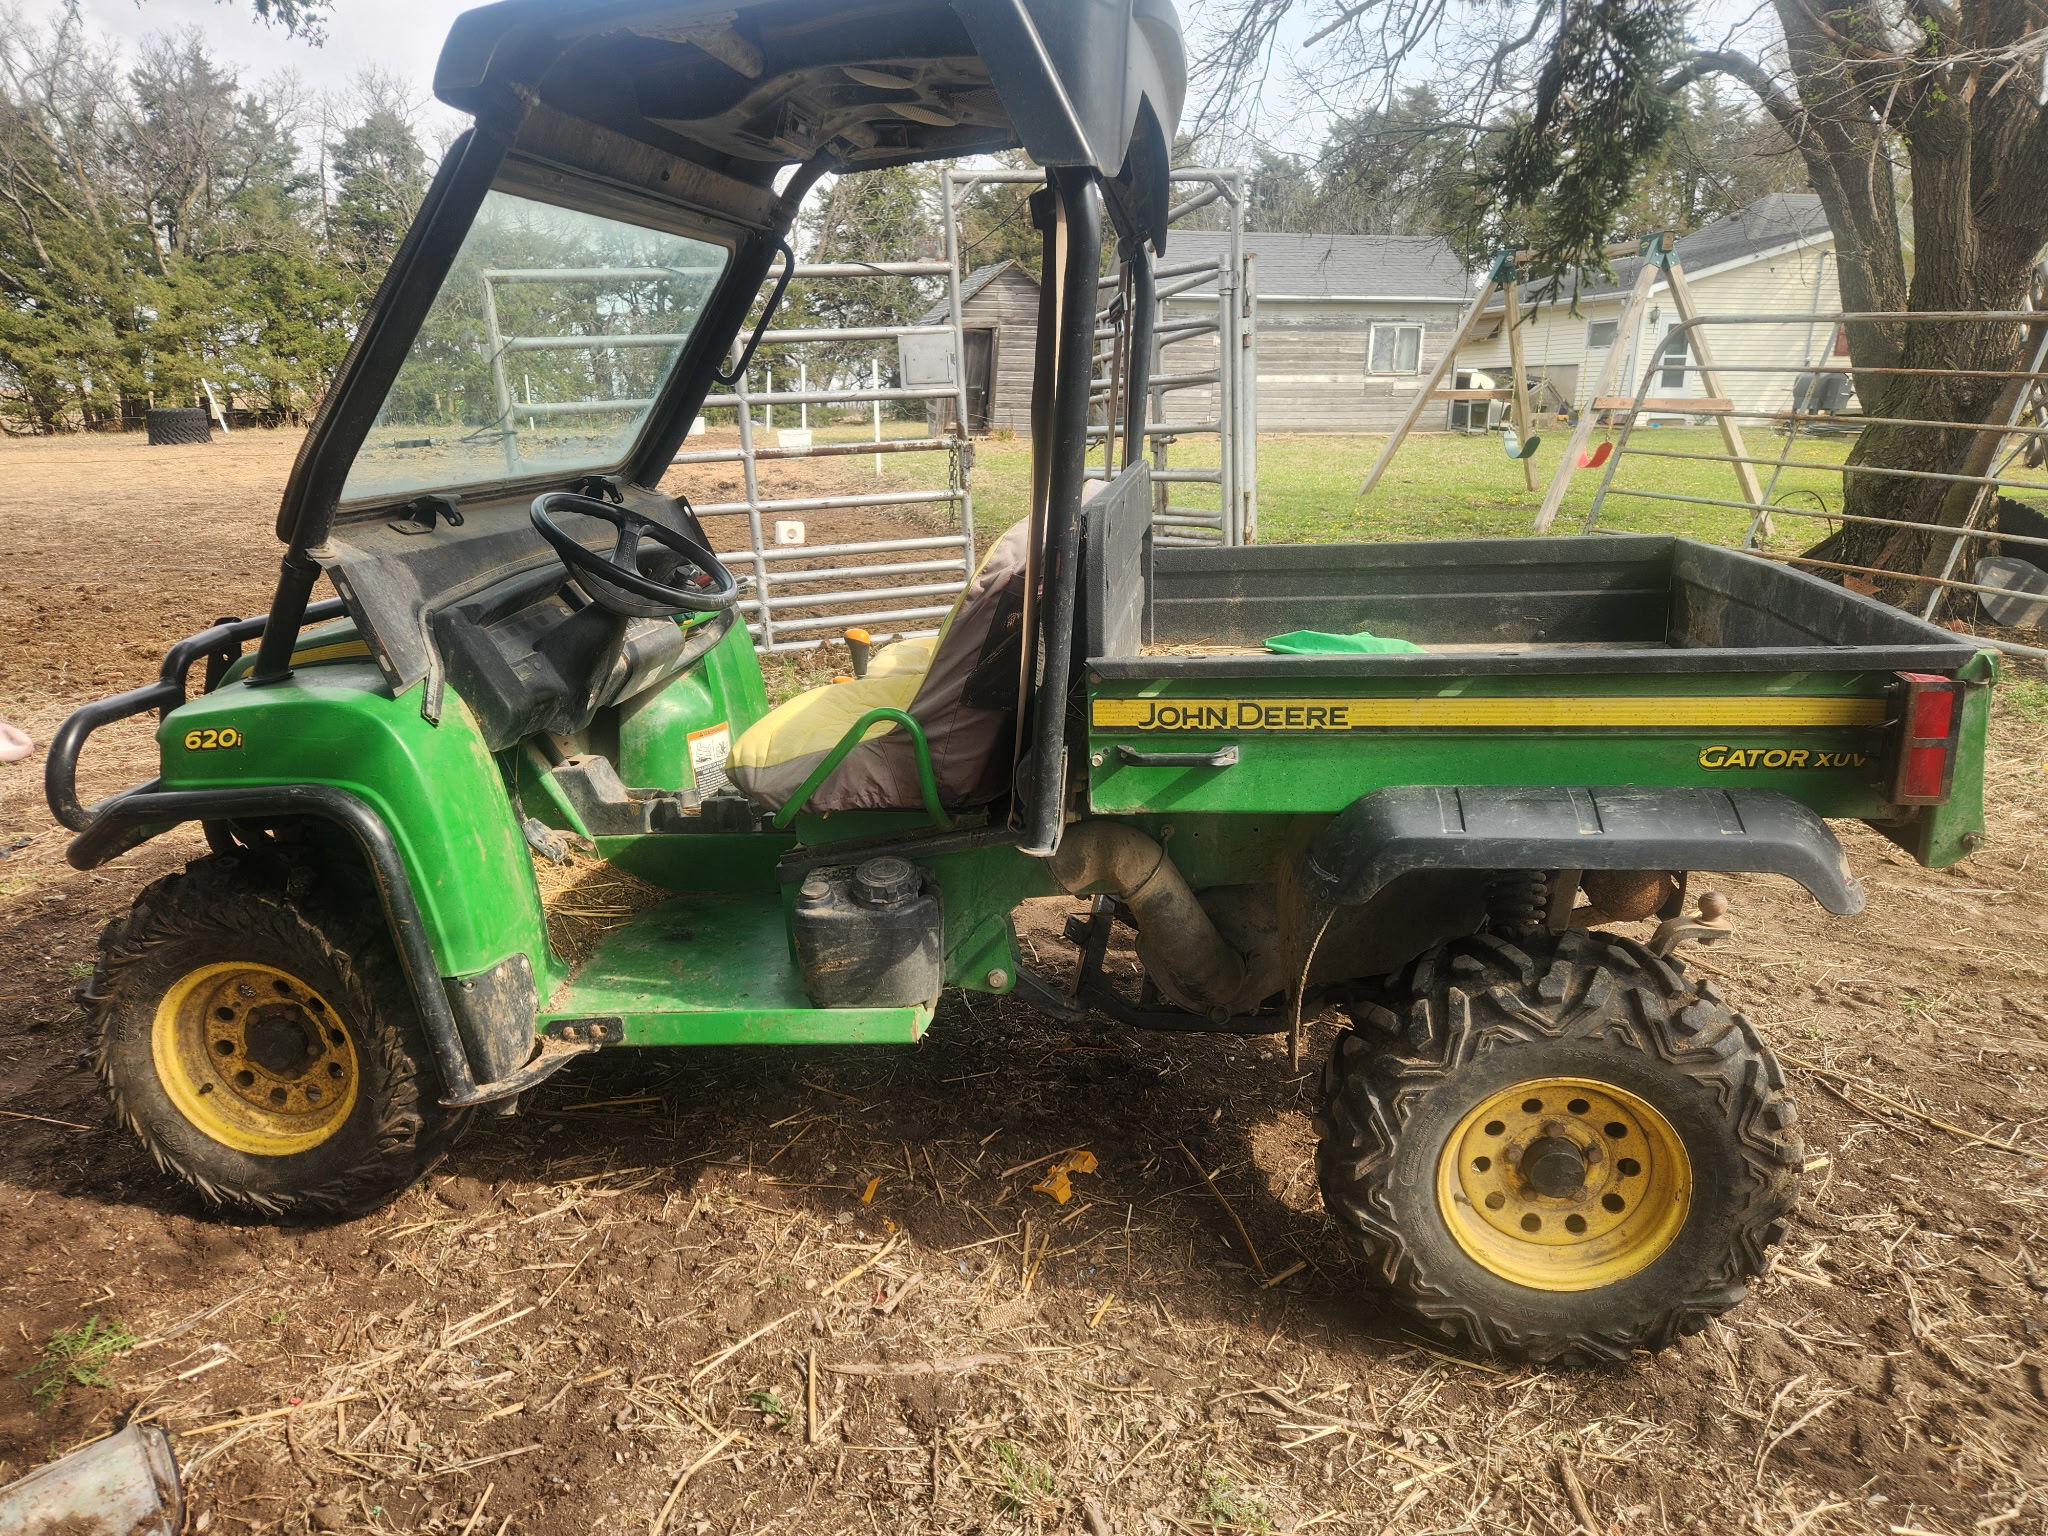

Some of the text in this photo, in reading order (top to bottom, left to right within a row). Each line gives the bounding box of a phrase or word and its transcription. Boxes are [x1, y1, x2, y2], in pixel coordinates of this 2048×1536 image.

[1138, 702, 1350, 727] JOHN DEERE
[184, 727, 242, 750] 620i
[1699, 745, 1867, 768] GATOR XUV
